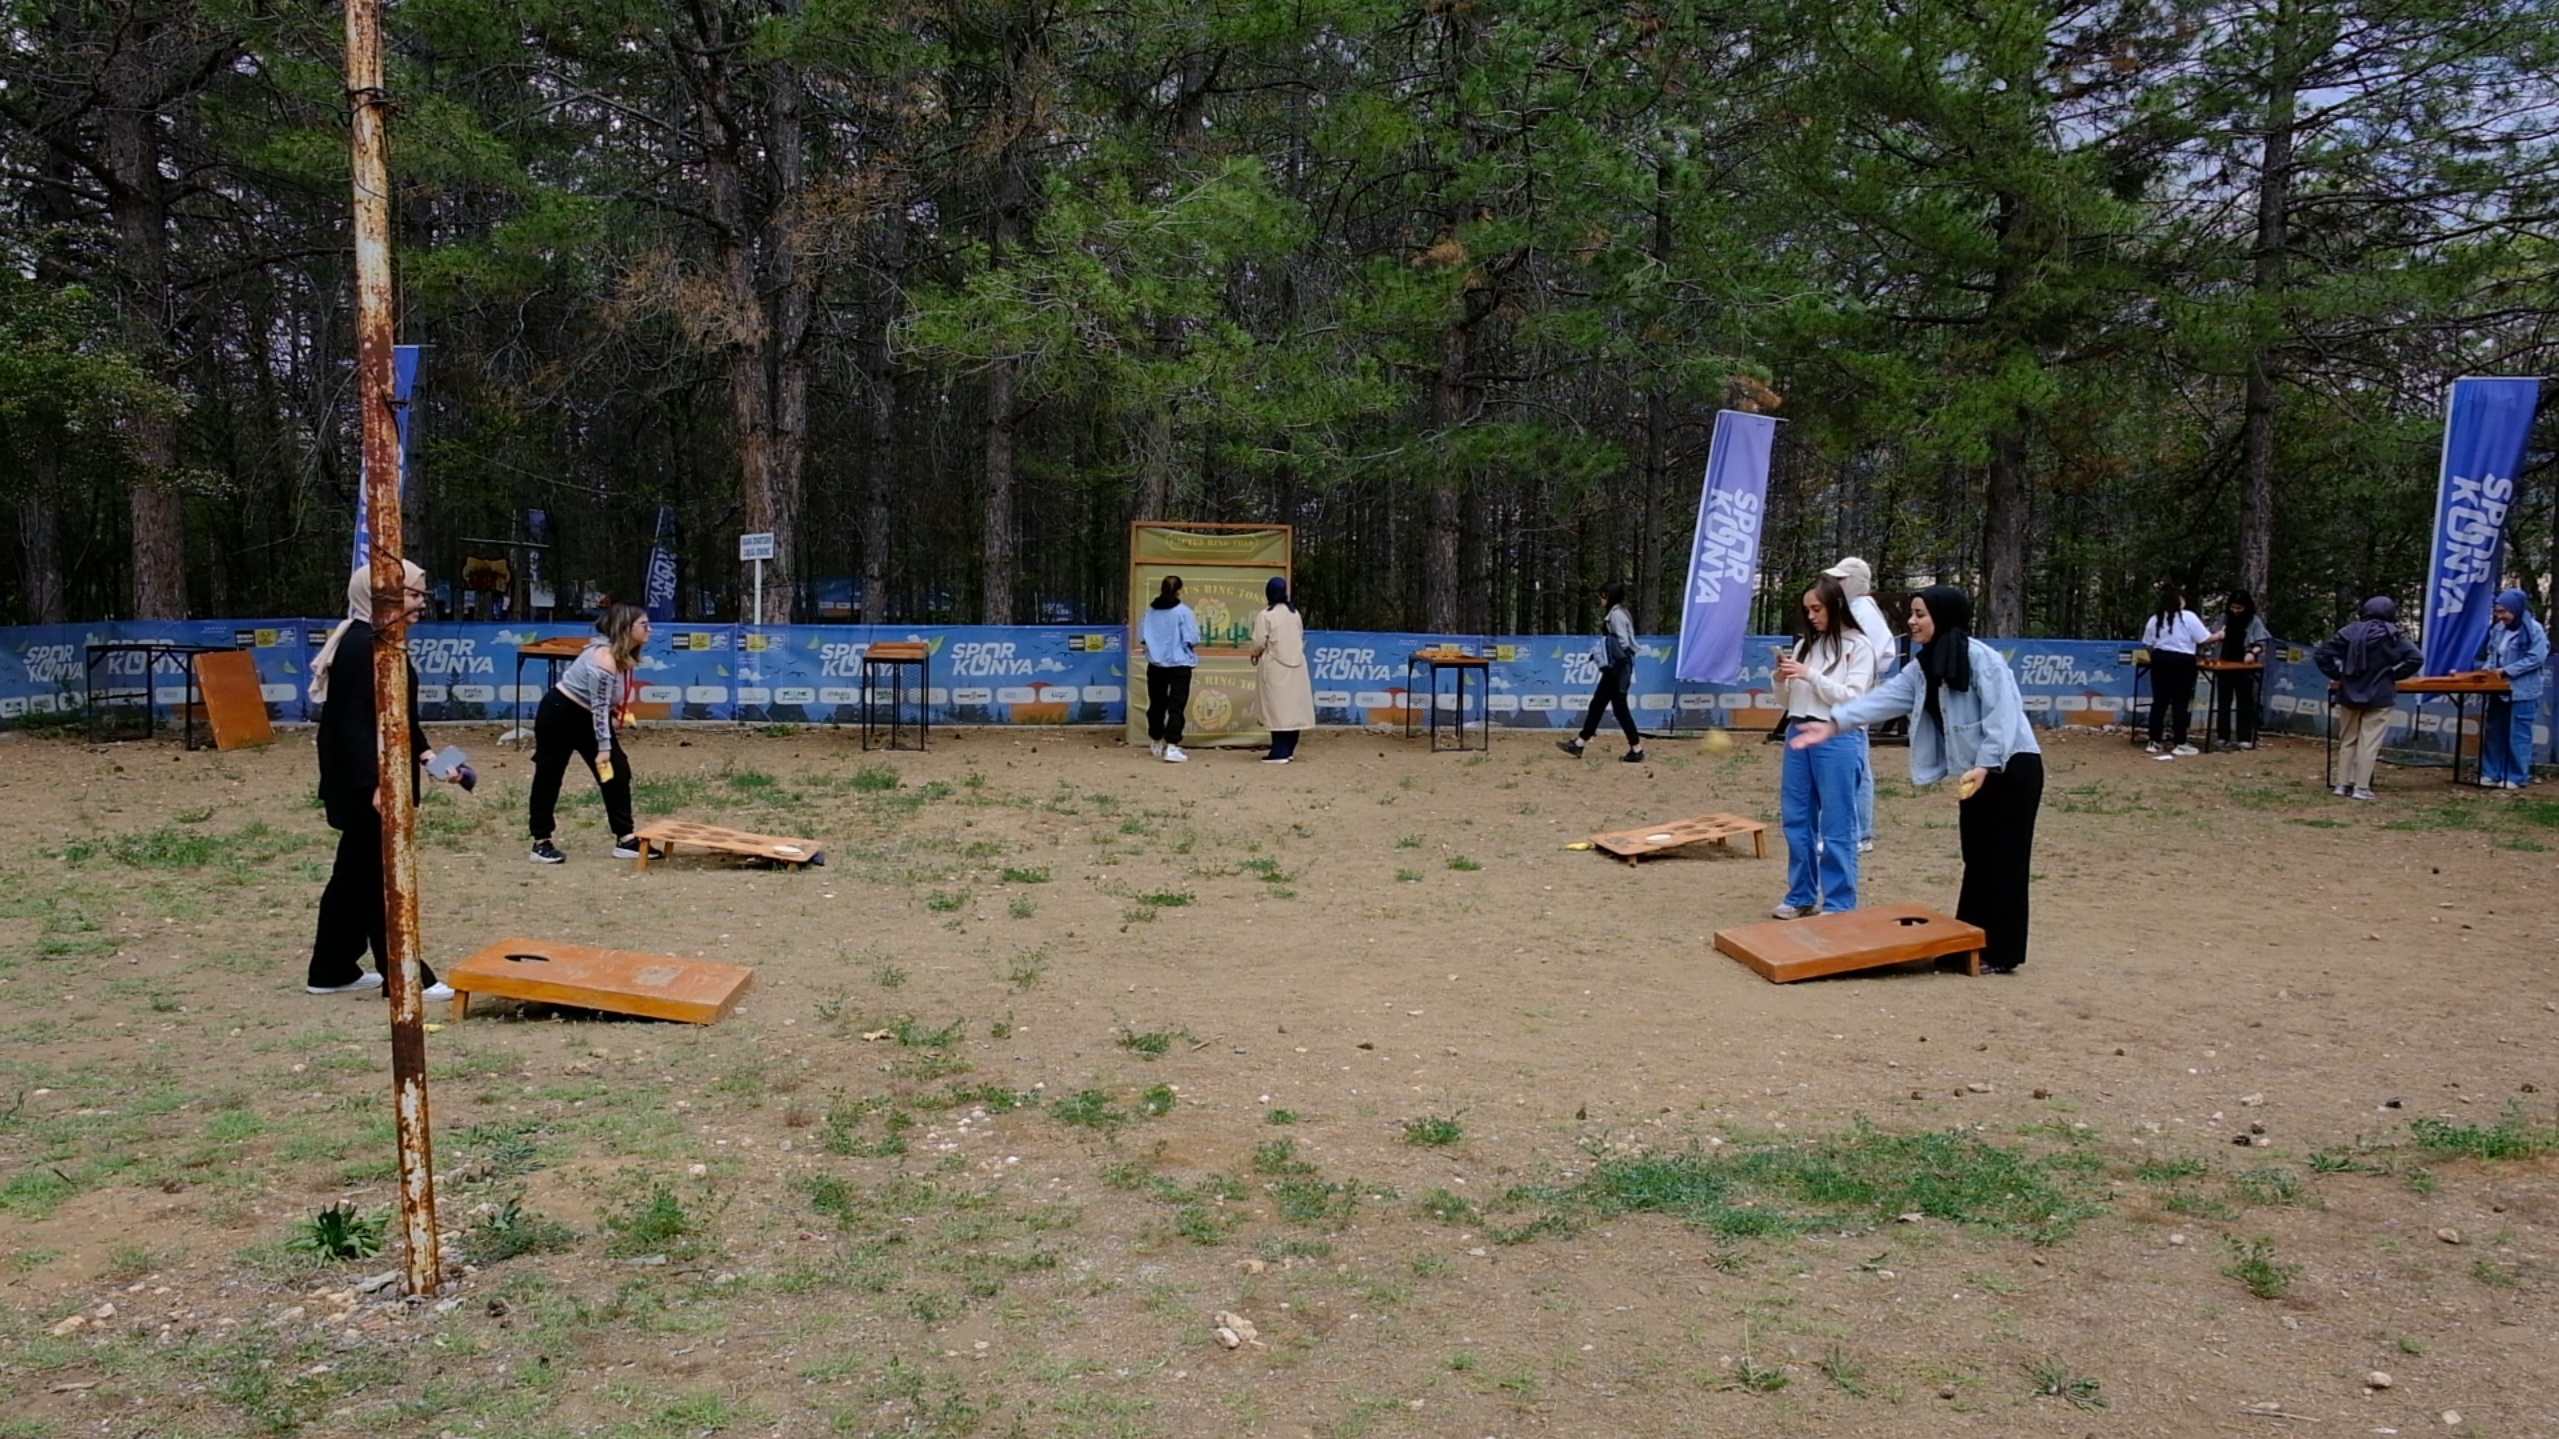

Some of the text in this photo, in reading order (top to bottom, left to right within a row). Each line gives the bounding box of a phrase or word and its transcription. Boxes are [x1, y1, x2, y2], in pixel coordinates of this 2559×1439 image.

[1722, 487, 1758, 585] SPOR
[2470, 472, 2514, 583] SPOR
[1695, 487, 1736, 604] KONYA
[2437, 474, 2487, 618] KONYA
[1204, 584, 1235, 596] RING
[22, 645, 74, 665] SPOR
[407, 638, 476, 658] SPOR
[819, 643, 871, 661] SPO
[951, 642, 1017, 661] SPOR
[1313, 648, 1375, 666] SPOR
[27, 659, 84, 683] KONYA
[411, 654, 494, 674] KONYA
[952, 656, 1034, 676] KONYA
[1314, 661, 1391, 681] KONYA
[2021, 654, 2074, 671] SPOR
[1205, 675, 1236, 687] RING
[2021, 667, 2088, 686] KONYA
